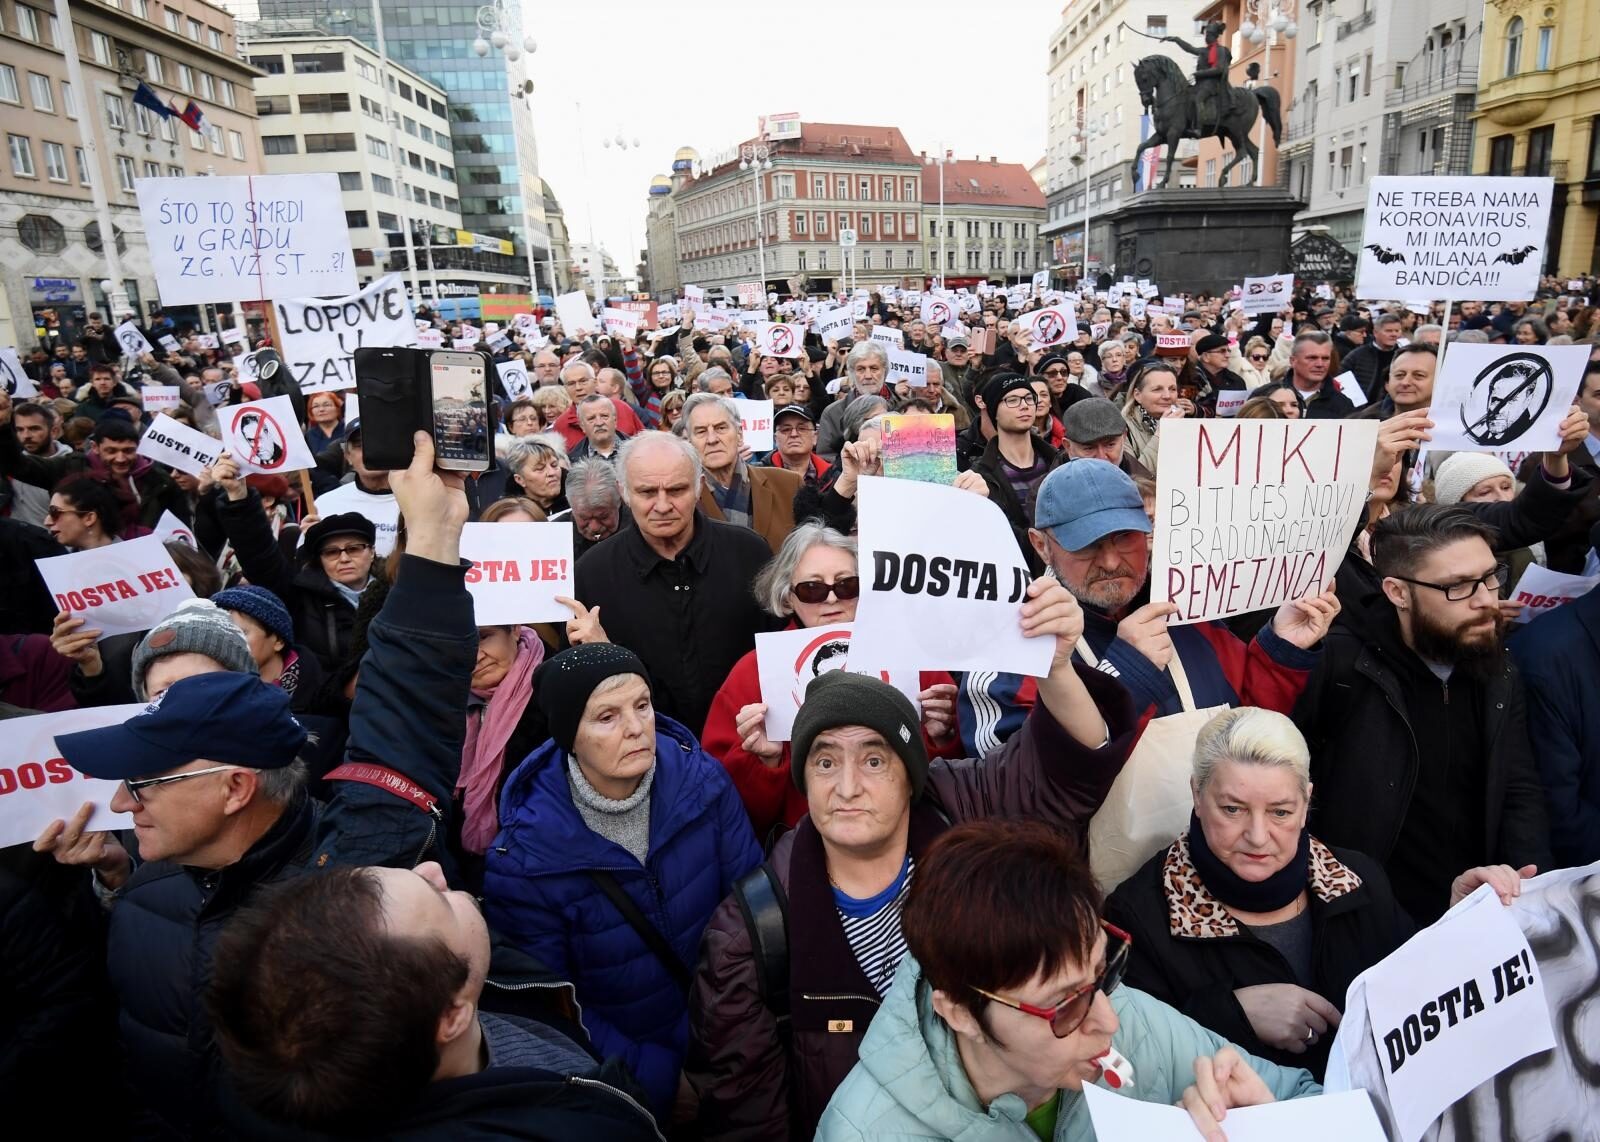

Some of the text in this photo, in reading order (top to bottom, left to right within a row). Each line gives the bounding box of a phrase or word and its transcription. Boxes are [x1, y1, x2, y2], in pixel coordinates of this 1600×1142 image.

[208, 202, 234, 224] TO
[245, 199, 303, 224] SMRDI
[1376, 191, 1540, 208] NE TREBA NAMA
[1379, 211, 1531, 229] KORONAVIRUS,
[198, 227, 291, 251] GRADU
[1406, 231, 1502, 247] MI IMAMO
[1299, 263, 1332, 271] KAVANA
[1304, 254, 1329, 262] MALA
[1413, 251, 1487, 266] MILANA
[1394, 267, 1501, 287] BANDIĆA!!!
[278, 287, 403, 334] LOPOVE
[338, 329, 363, 355] U
[1158, 337, 1186, 345] DOSTA
[294, 356, 355, 388] ZAT
[912, 366, 925, 375] JE!
[751, 419, 770, 431] JE!
[147, 429, 191, 456] DOSTA
[1197, 423, 1343, 487] MIKI
[1170, 486, 1235, 527] BITI
[1301, 483, 1355, 519] NOVI
[465, 558, 567, 583] STA JE!
[871, 550, 998, 601] DOSTA
[55, 567, 180, 613] DOSTA JE!
[1166, 550, 1326, 623] REMETINCA
[1516, 591, 1579, 608] DOS
[0, 757, 93, 796] DOS
[1383, 947, 1535, 1075] DOSTA JE!
